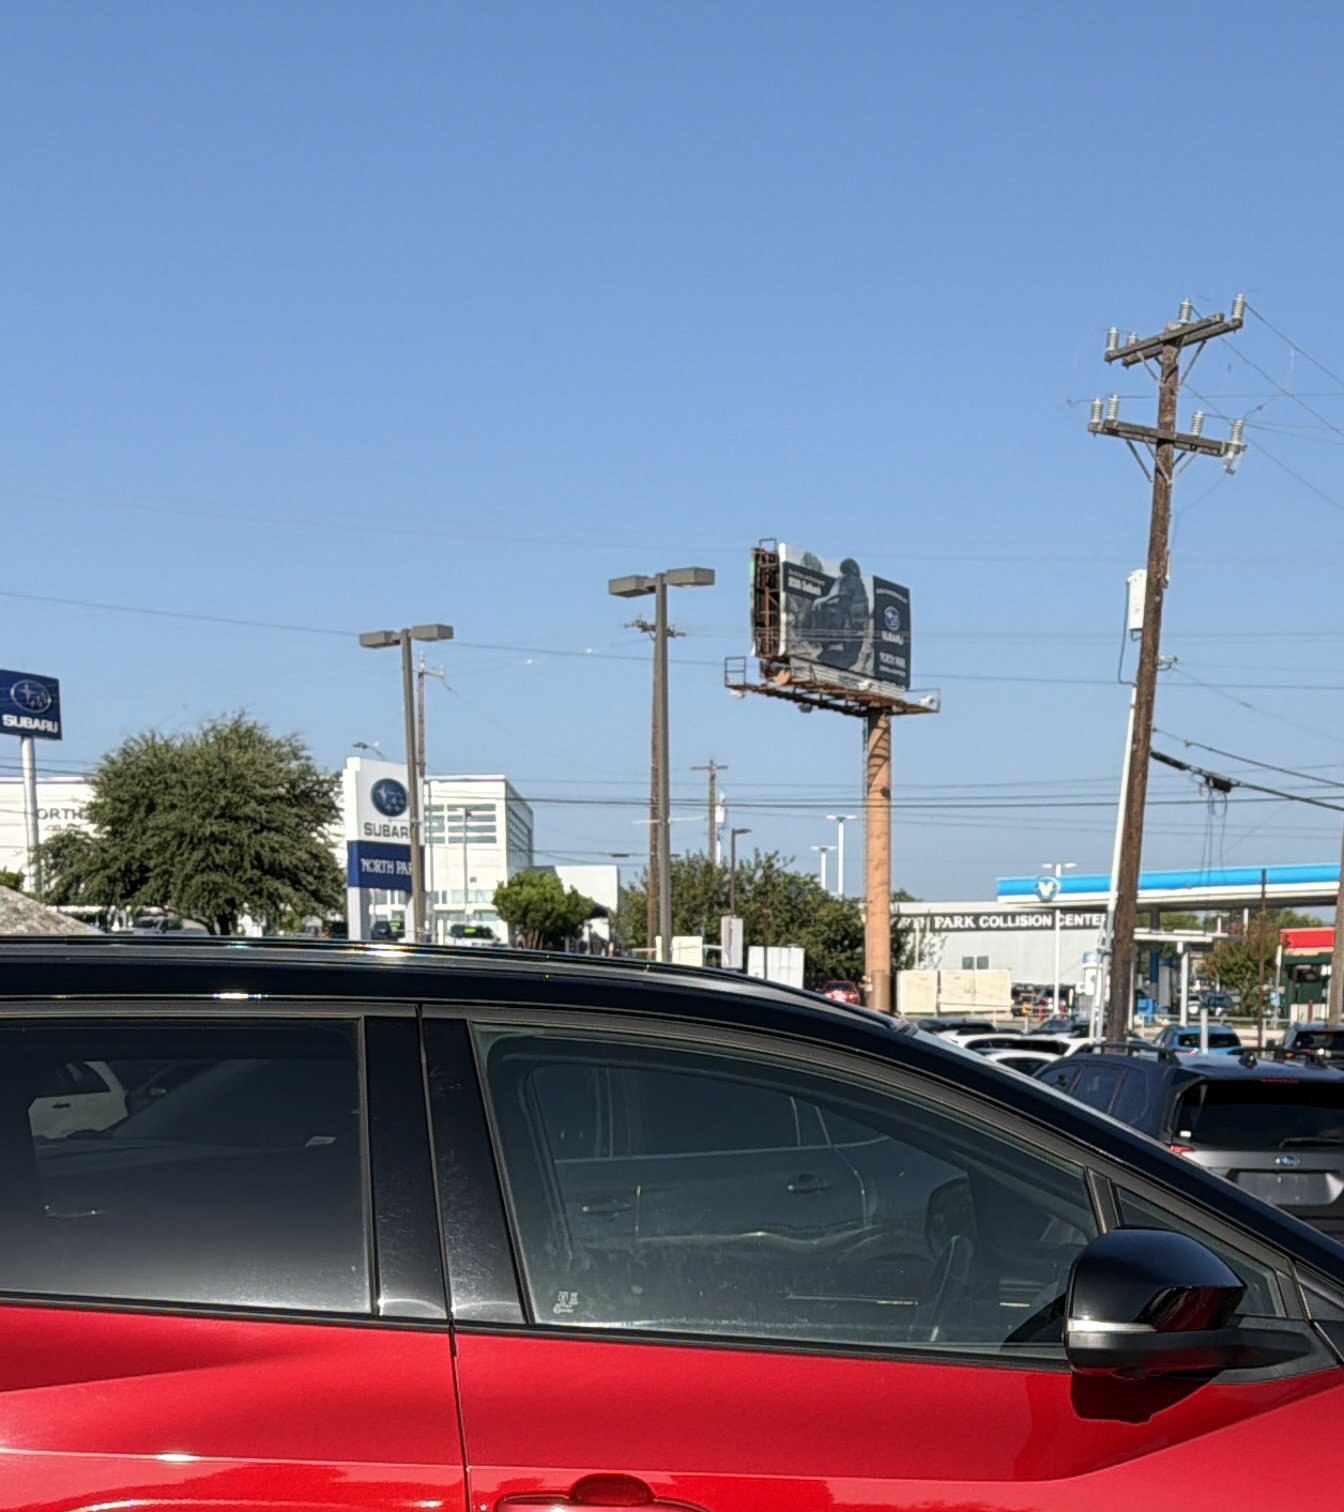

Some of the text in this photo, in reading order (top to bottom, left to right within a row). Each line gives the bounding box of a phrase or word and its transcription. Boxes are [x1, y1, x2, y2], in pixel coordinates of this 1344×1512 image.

[2, 714, 58, 733] SUBARU
[38, 808, 83, 820] ORTH
[364, 822, 409, 839] SUBAR
[360, 858, 394, 874] NORTH
[934, 916, 976, 928] PARK
[979, 914, 1052, 927] COLLISION
